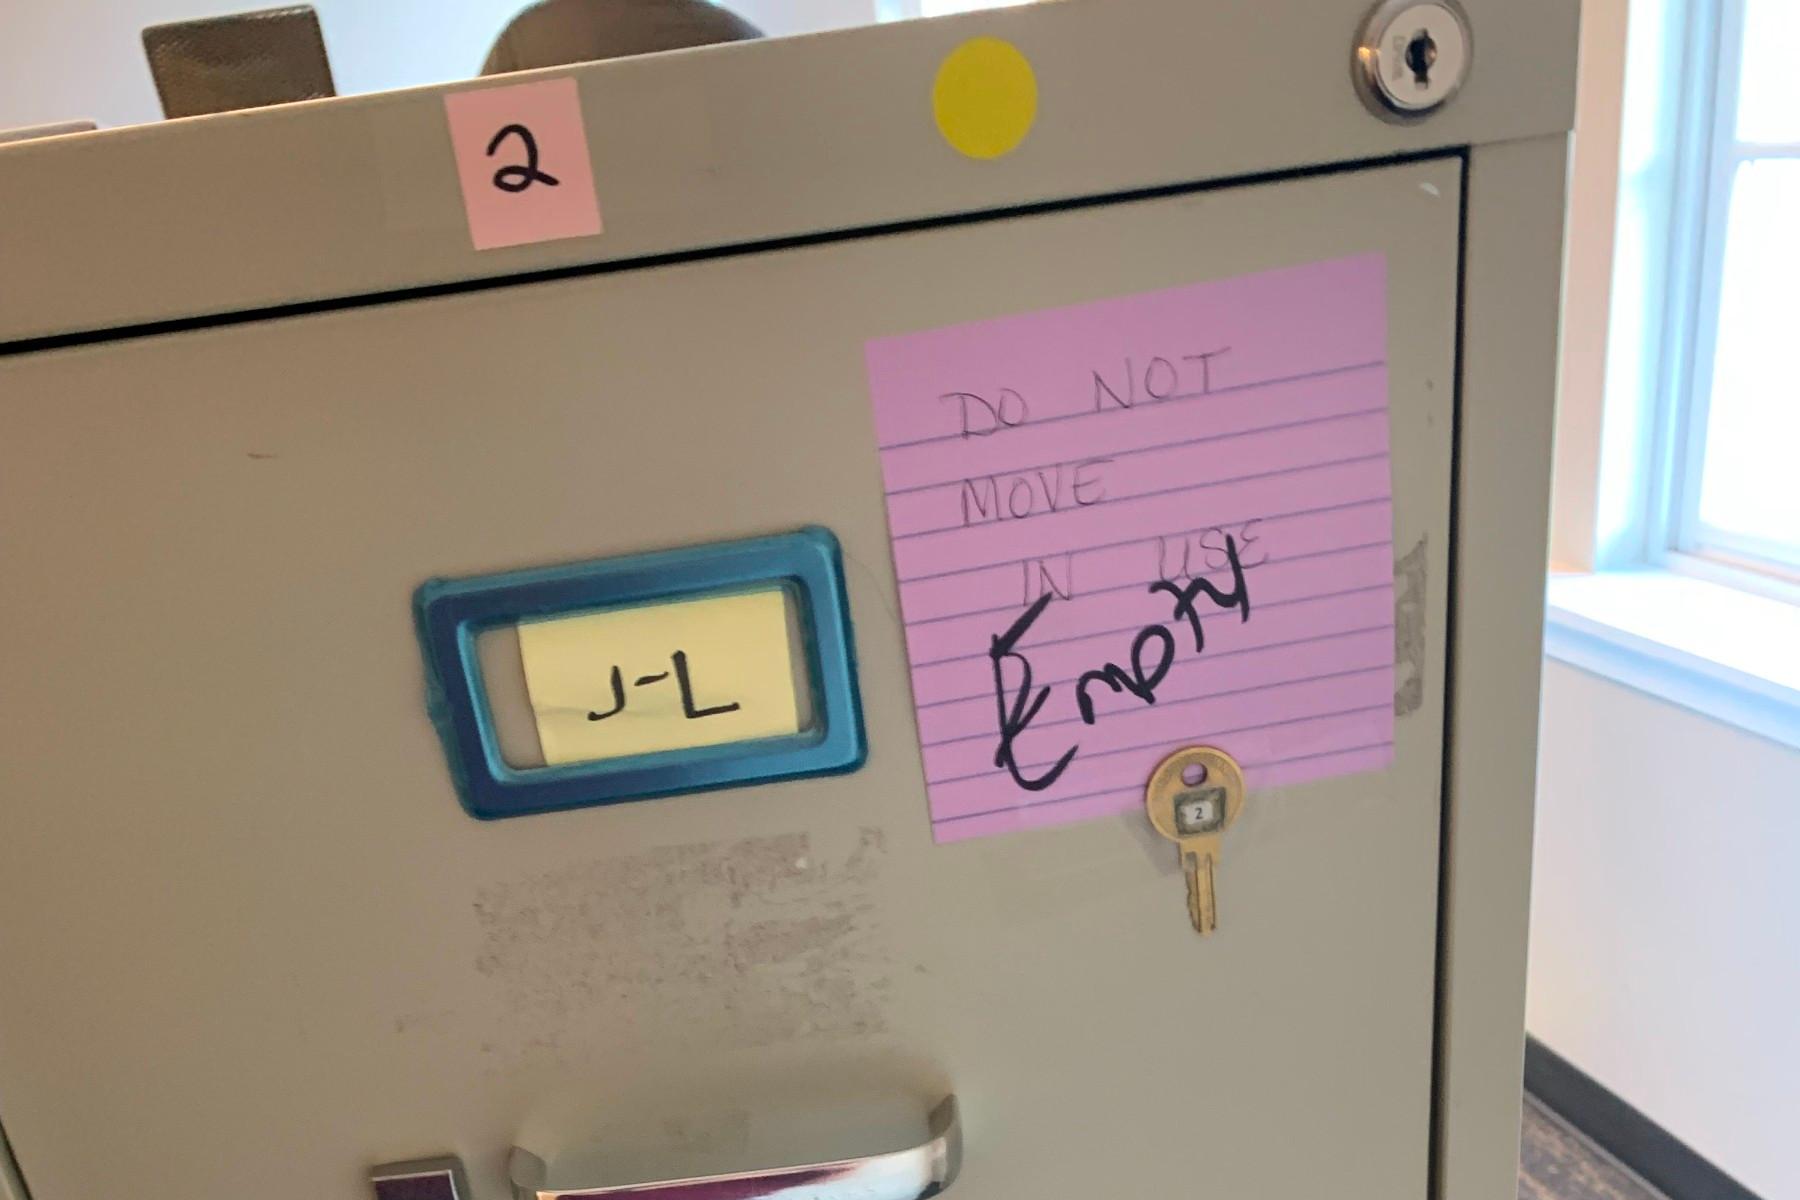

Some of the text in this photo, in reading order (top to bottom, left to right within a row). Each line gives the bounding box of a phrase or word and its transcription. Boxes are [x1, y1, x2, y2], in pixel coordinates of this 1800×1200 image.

[486, 123, 560, 193] 2
[940, 347, 1232, 440] DO NOT
[960, 457, 1115, 528] MOVE
[1020, 518, 1270, 607] IN USE
[587, 649, 741, 722] J-L
[1194, 807, 1204, 820] 2
